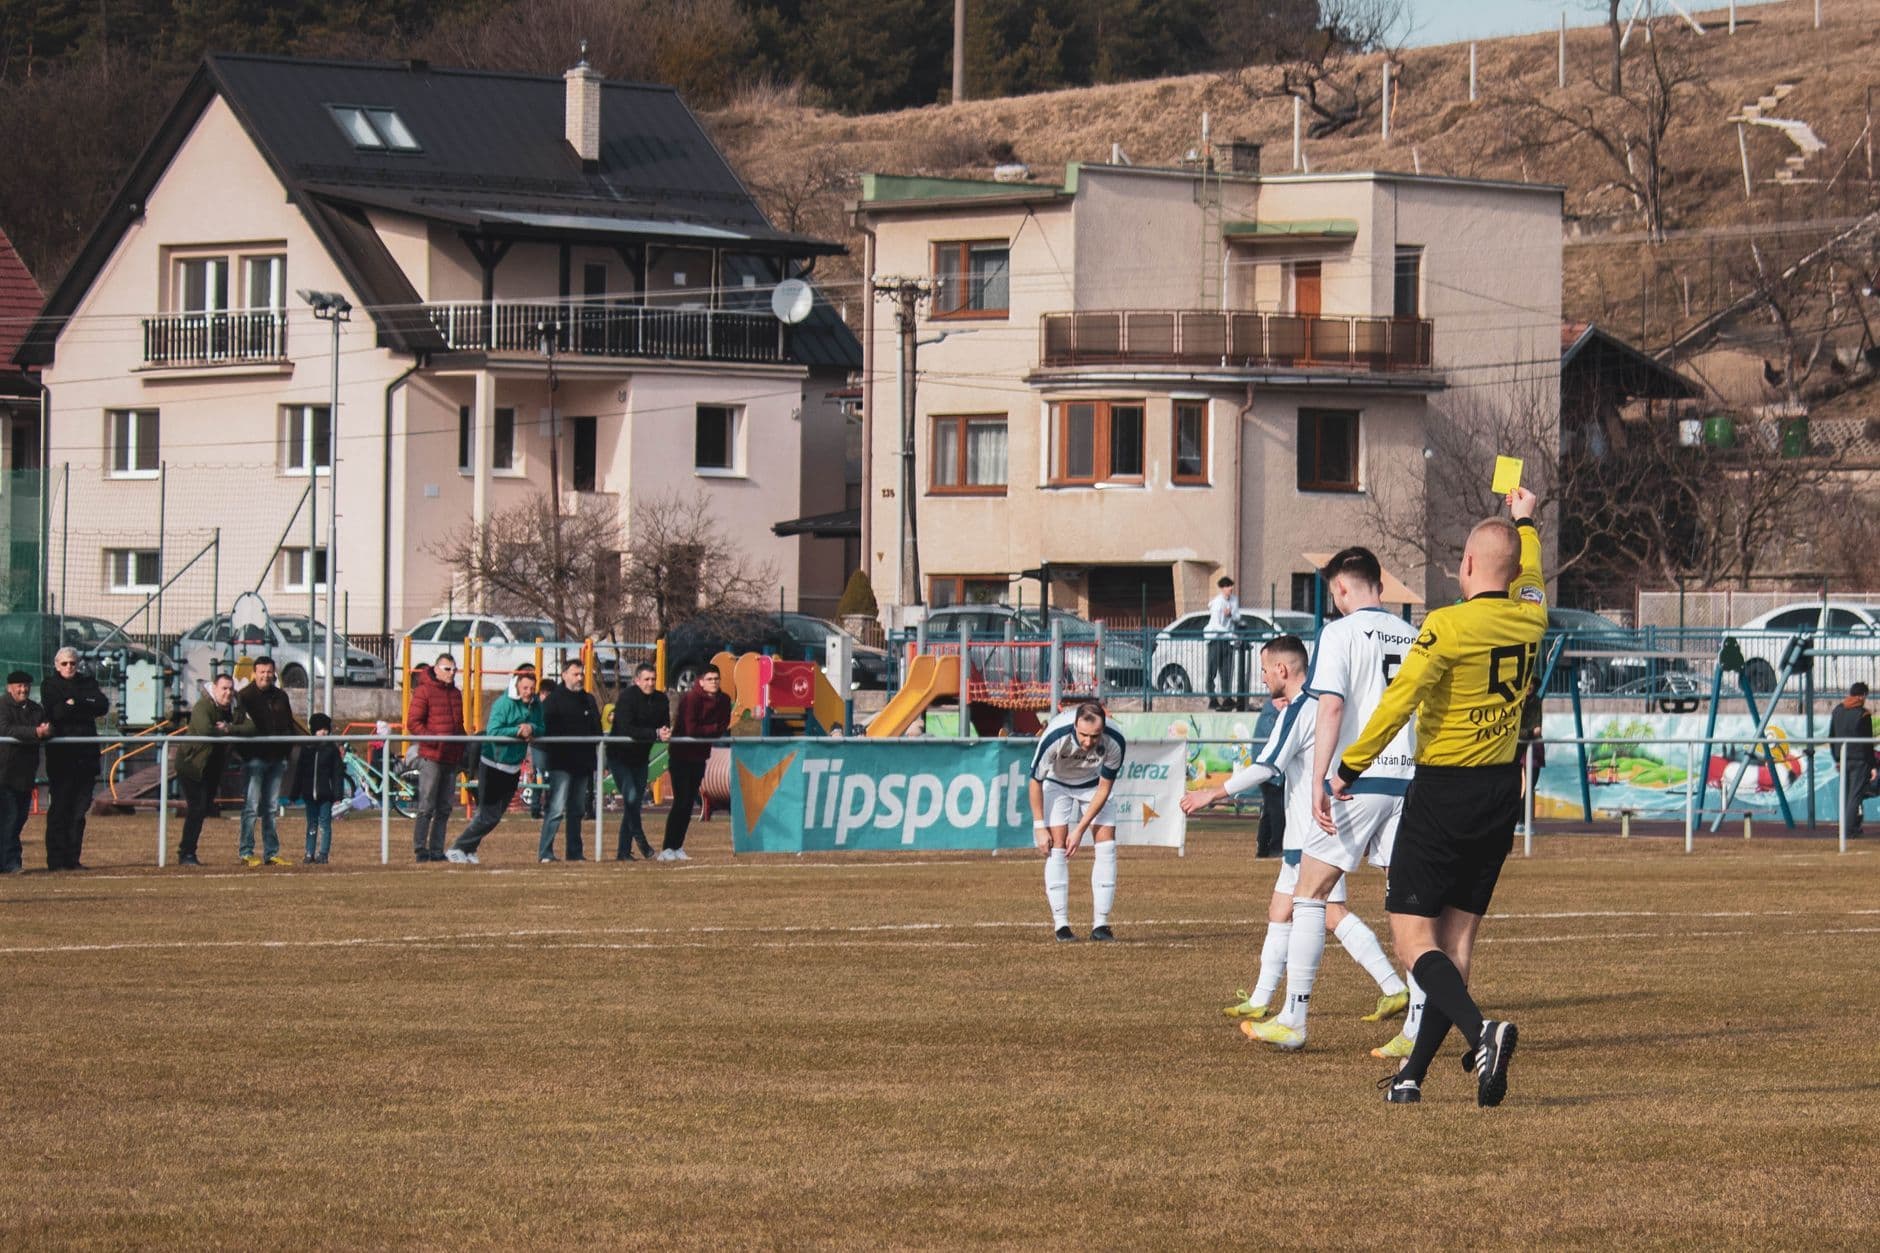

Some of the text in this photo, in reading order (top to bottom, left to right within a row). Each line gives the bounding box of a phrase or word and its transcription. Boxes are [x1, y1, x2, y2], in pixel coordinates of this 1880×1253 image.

[1376, 630, 1416, 645] Tipspor
[1127, 760, 1170, 780] teraz
[802, 758, 1026, 845] Tipsport
